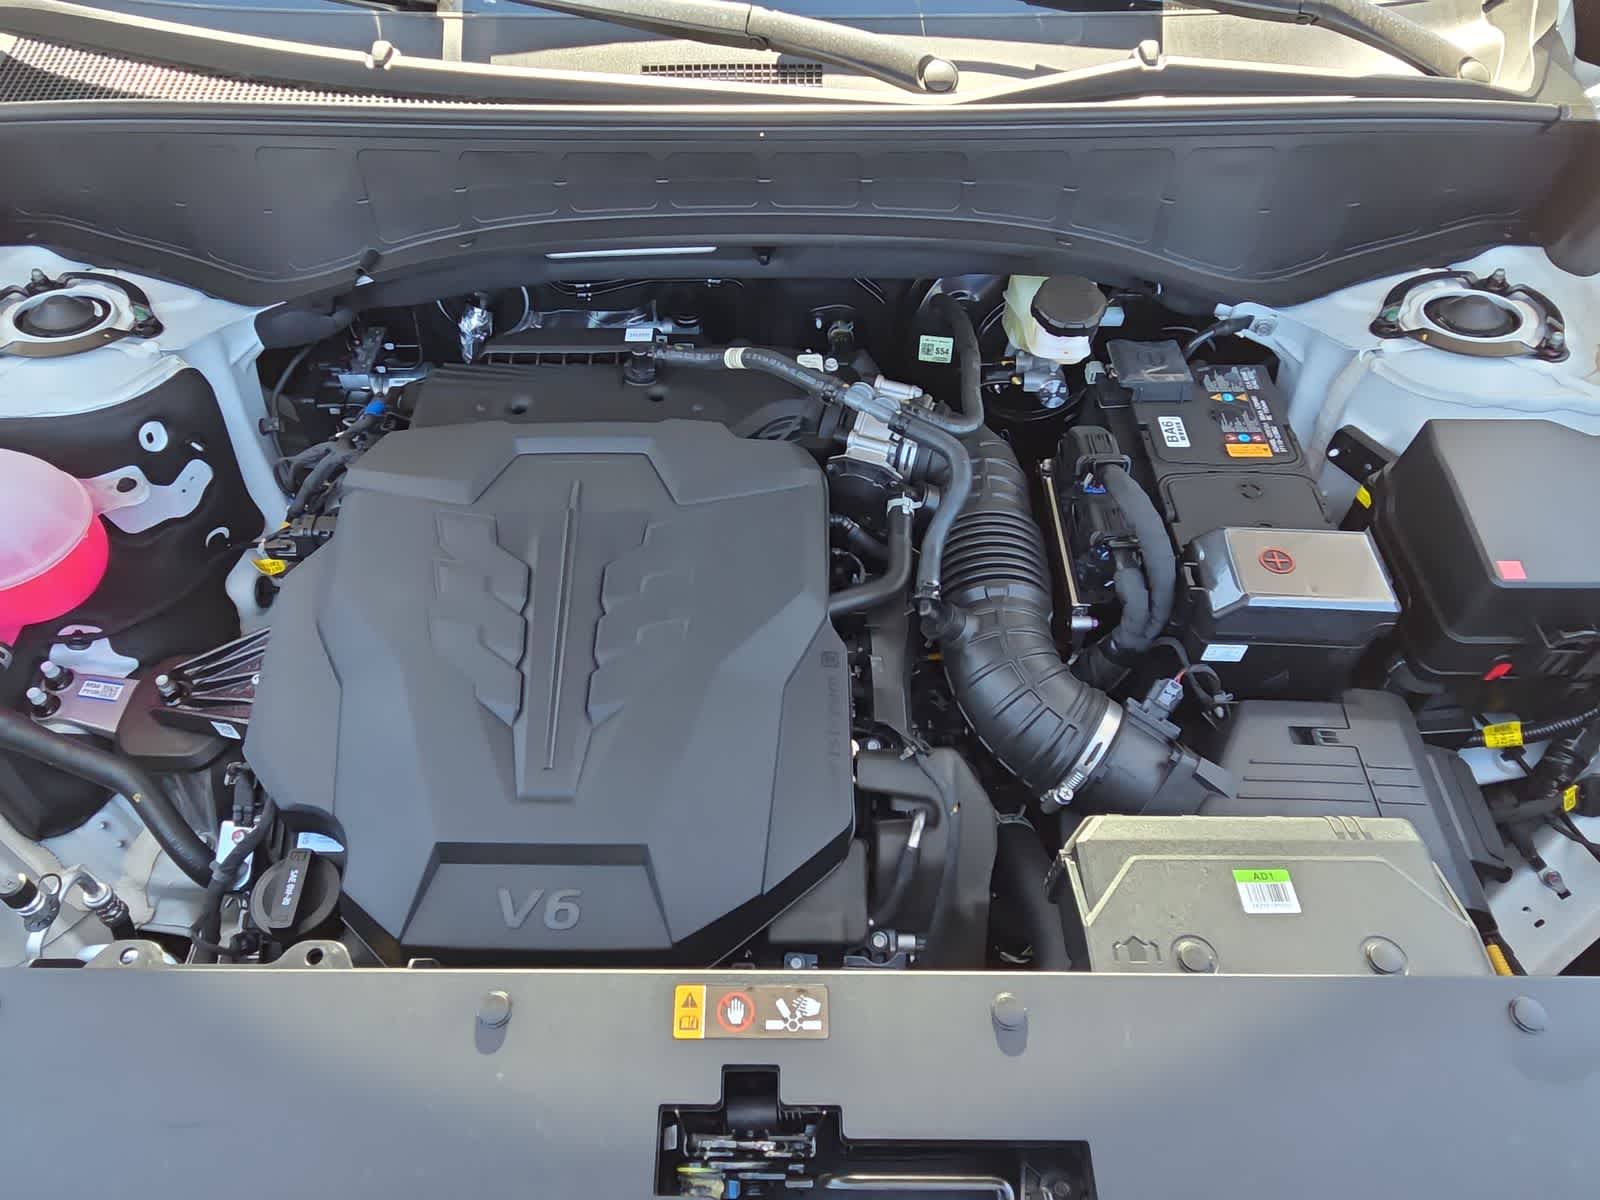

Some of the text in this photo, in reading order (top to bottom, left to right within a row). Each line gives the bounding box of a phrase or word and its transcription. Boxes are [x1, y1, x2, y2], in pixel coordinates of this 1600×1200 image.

[1161, 420, 1180, 443] BA6
[1253, 872, 1274, 880] AD1
[497, 888, 584, 930] V6
